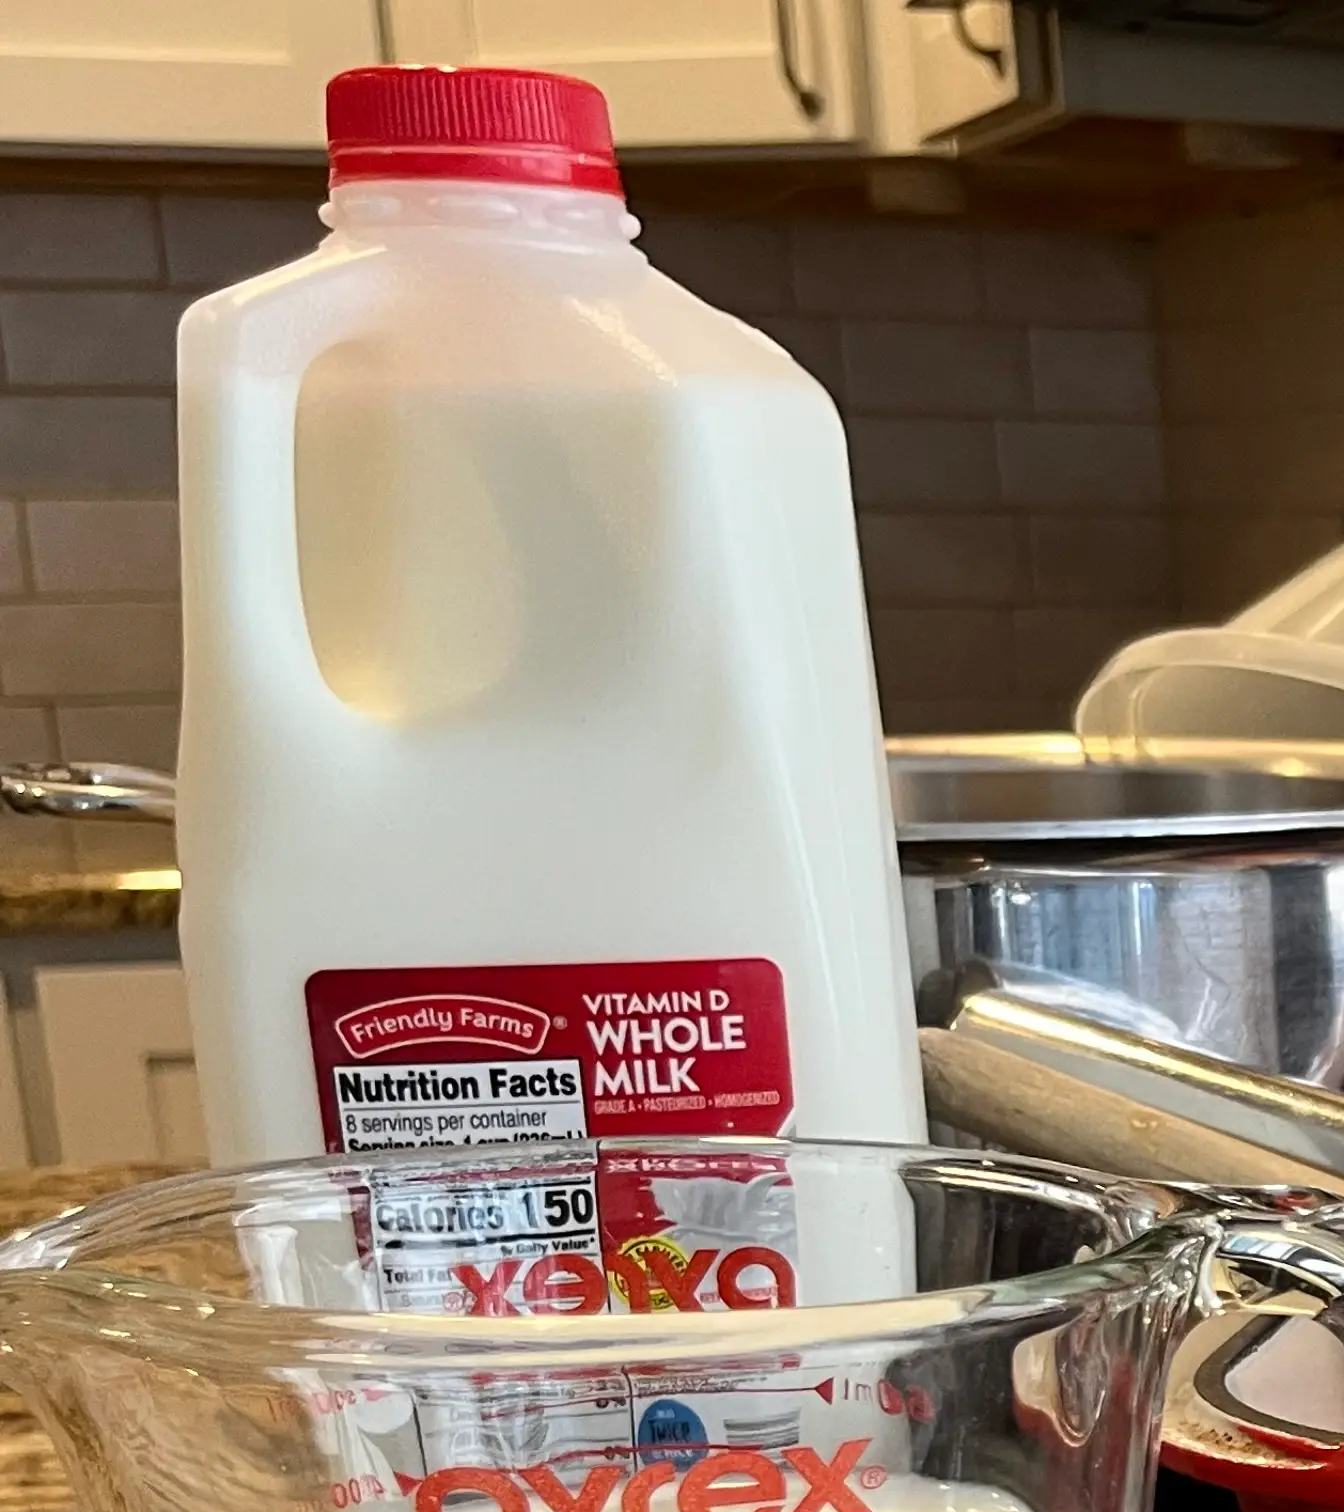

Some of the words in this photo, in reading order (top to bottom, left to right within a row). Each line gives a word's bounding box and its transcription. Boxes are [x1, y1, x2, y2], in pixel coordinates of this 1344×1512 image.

[582, 990, 702, 1015] VITAMIN
[709, 989, 730, 1011] D
[350, 1007, 452, 1042] Friendly
[460, 1008, 535, 1038] Farms
[586, 1015, 747, 1055] WHOLE
[338, 1070, 479, 1104] Nutrition
[489, 1067, 577, 1099] Facts
[594, 1057, 701, 1096] MILK
[345, 1114, 357, 1133] 8
[362, 1112, 433, 1136] servings
[438, 1114, 465, 1136] per
[470, 1108, 547, 1130] container
[376, 1202, 505, 1234] Calories
[520, 1188, 595, 1230] 150
